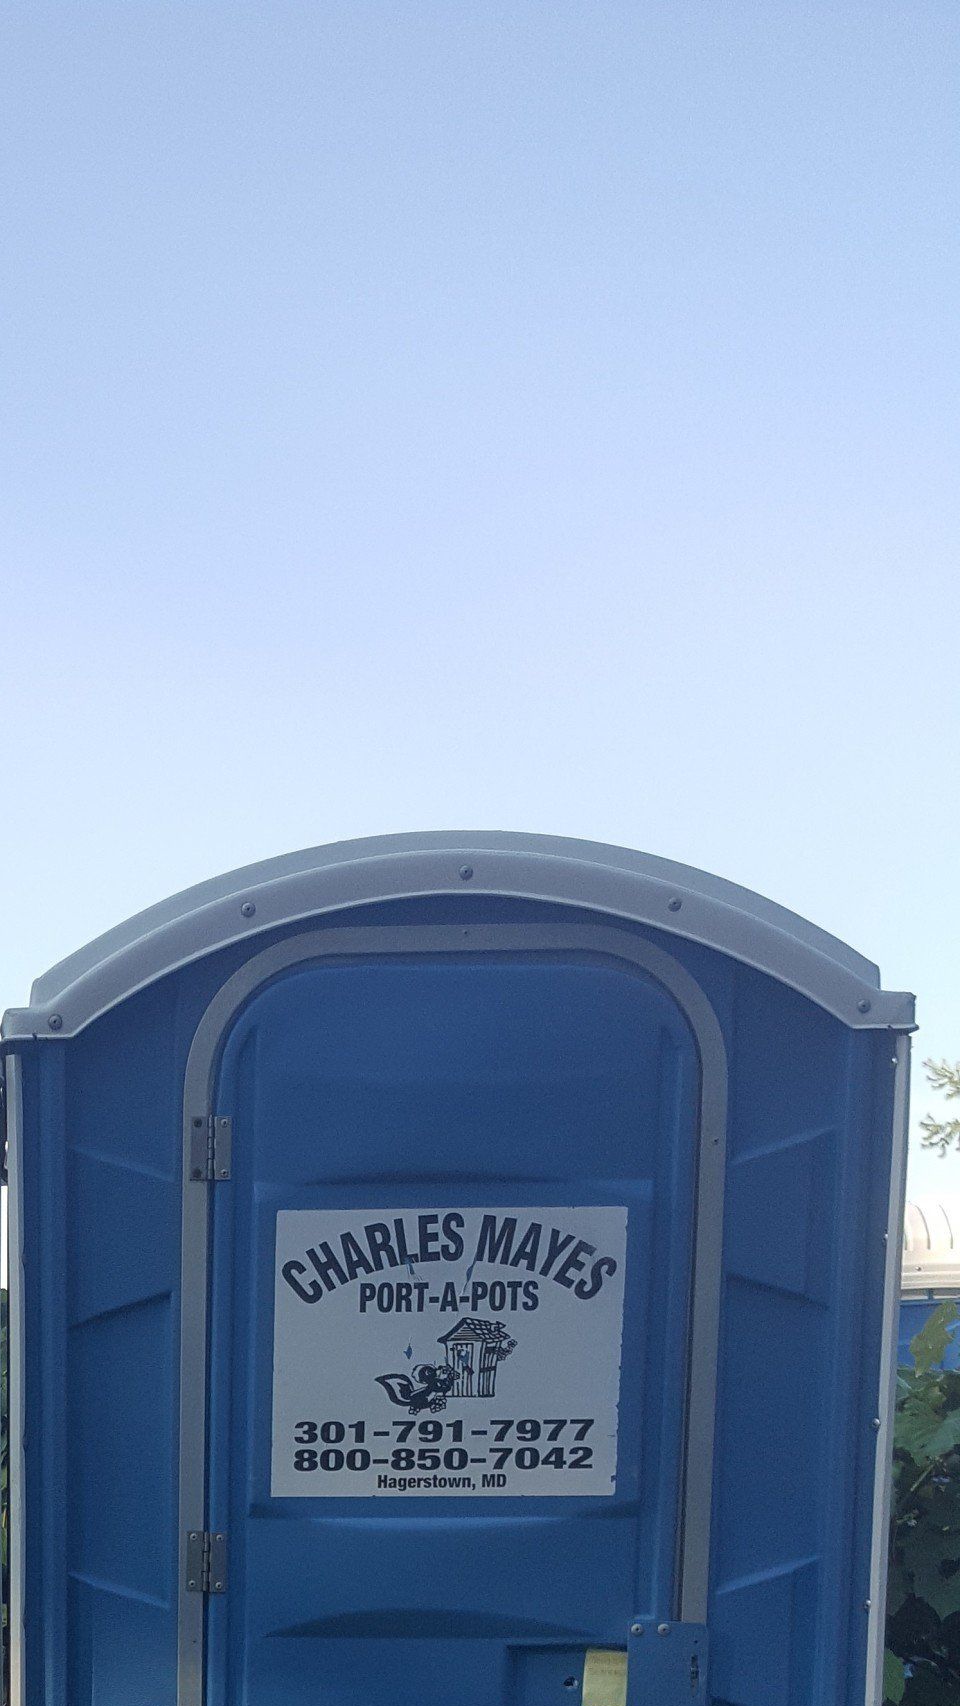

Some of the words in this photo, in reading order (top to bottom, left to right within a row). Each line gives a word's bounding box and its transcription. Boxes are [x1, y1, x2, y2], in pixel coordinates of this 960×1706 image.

[281, 1212, 466, 1304] CHARLES
[475, 1214, 617, 1301] MAYES
[359, 1280, 539, 1313] PORT-A-POTS
[294, 1419, 595, 1444] 301-791-7977
[293, 1447, 593, 1471] 800-850-7042
[377, 1474, 476, 1492] Hagerstown,
[482, 1475, 507, 1489] MD
